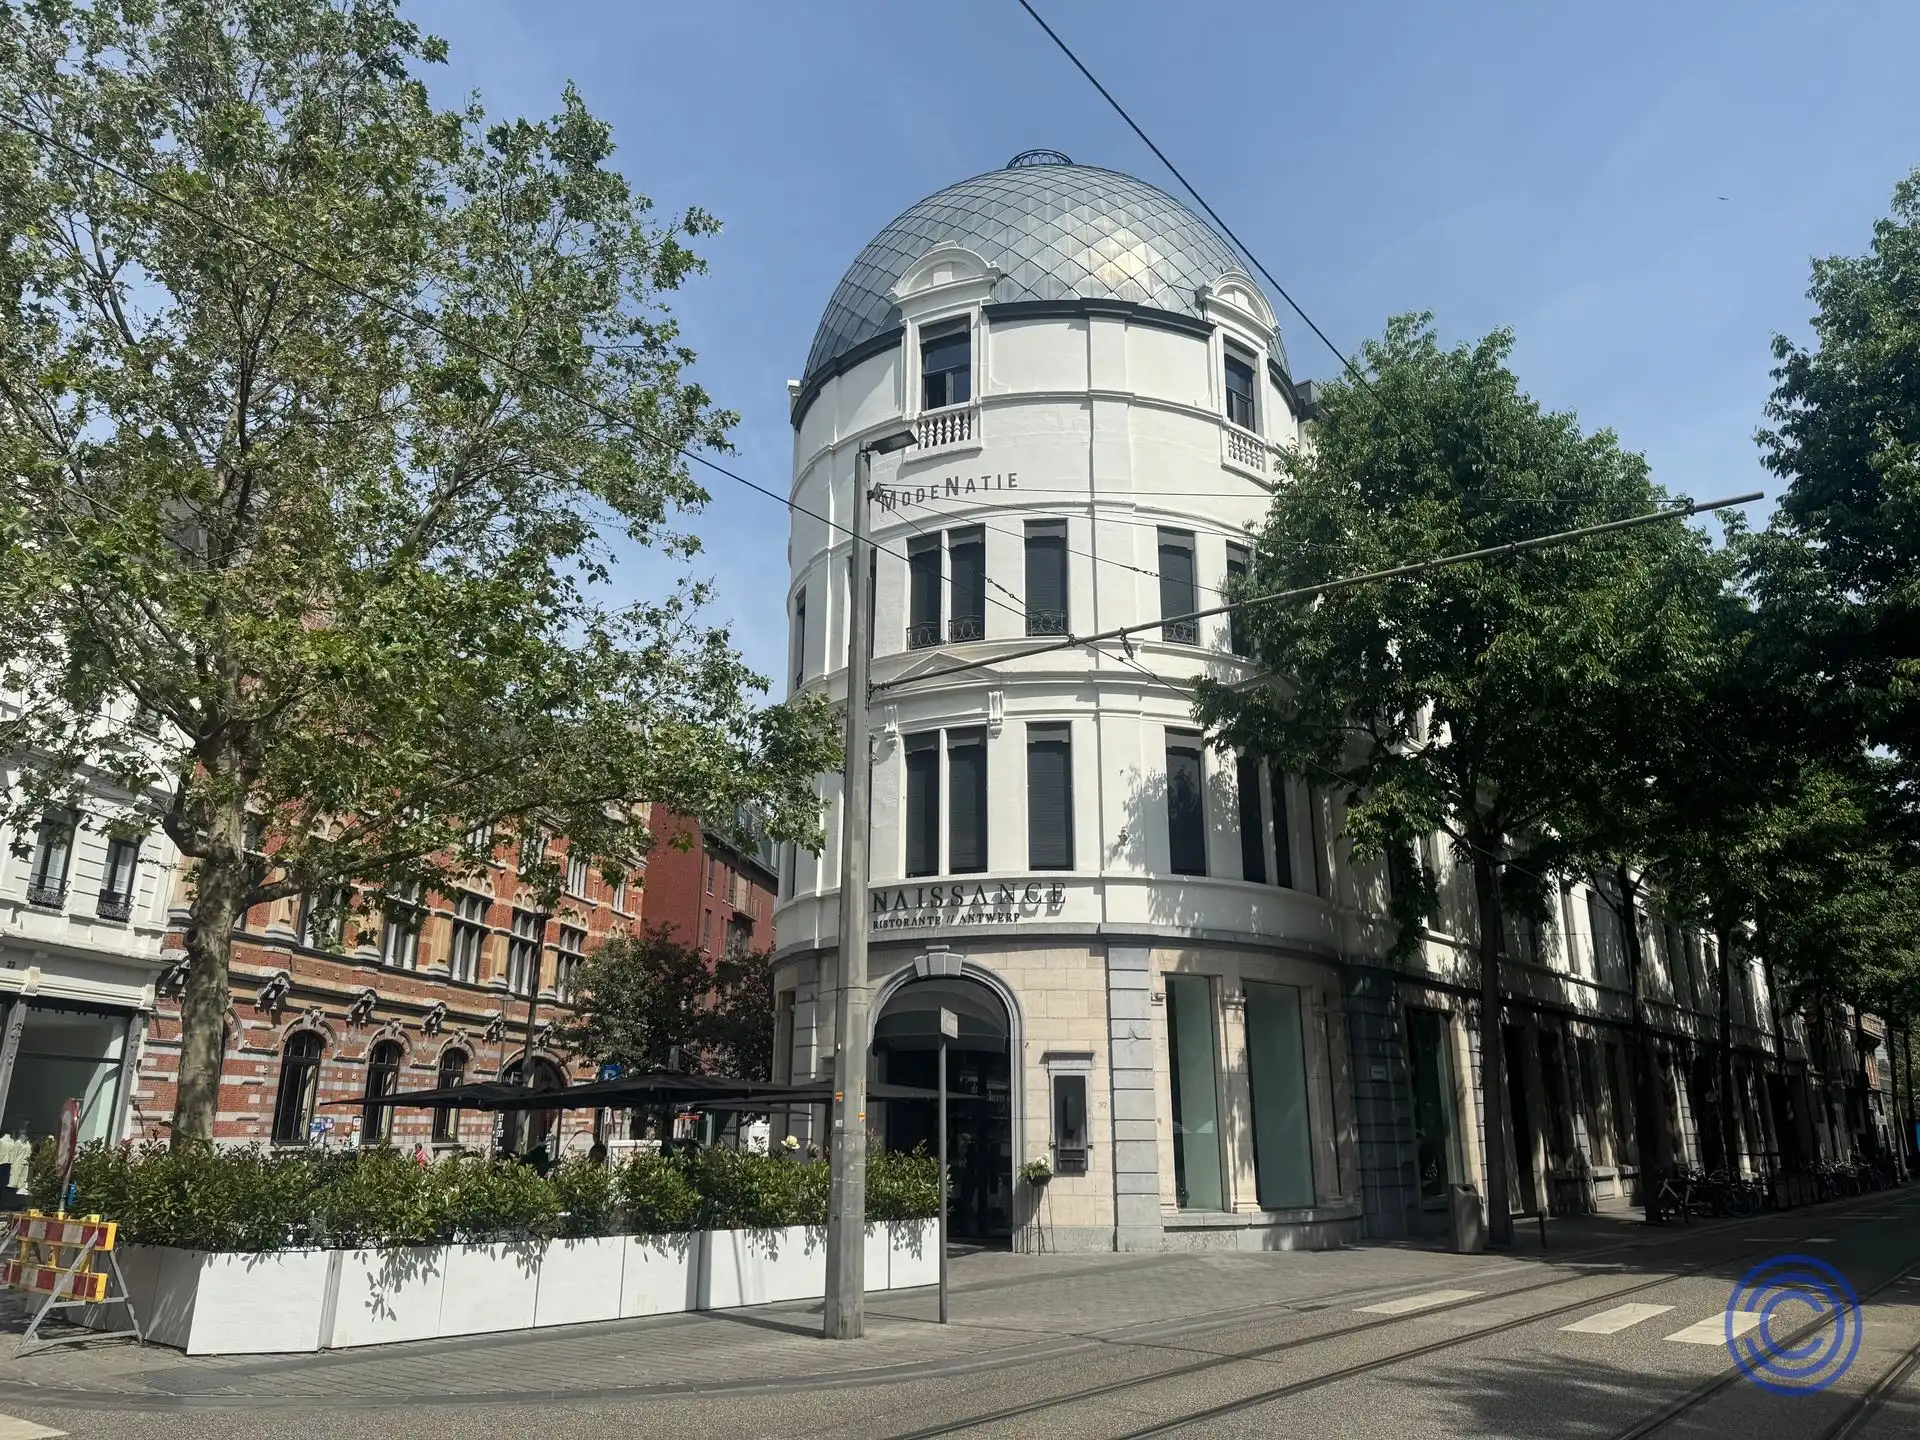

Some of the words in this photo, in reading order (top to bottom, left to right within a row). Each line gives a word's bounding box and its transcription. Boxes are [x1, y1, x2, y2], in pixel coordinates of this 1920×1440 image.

[872, 881, 1067, 913] NAISSANCE
[872, 915, 942, 930] RISTORANTE
[959, 912, 1021, 924] ANTWERP
